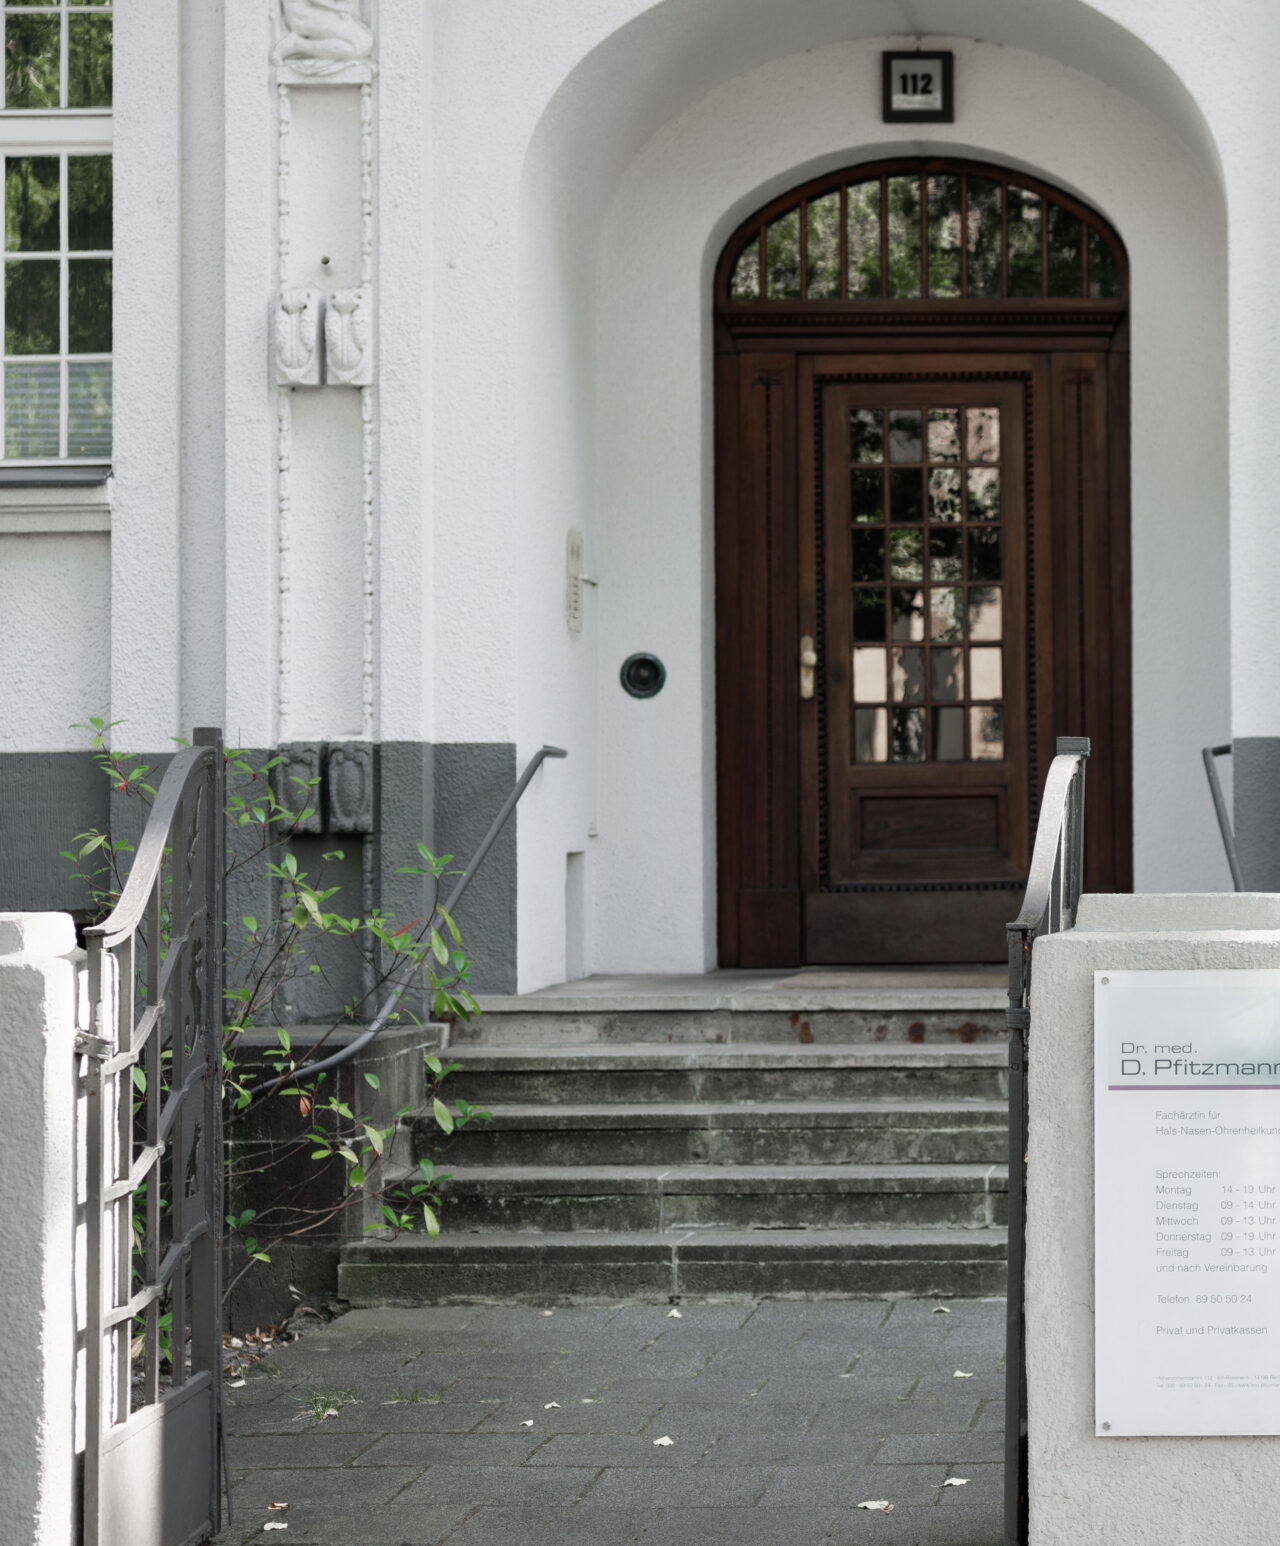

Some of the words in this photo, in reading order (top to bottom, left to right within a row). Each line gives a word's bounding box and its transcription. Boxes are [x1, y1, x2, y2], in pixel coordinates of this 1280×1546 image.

[900, 73, 933, 95] 112
[1121, 1042, 1148, 1054] Dr.
[1154, 1042, 1198, 1054] med.
[1121, 1059, 1146, 1076] D.
[1155, 1110, 1206, 1120] Fachärztin
[1208, 1110, 1221, 1120] für
[1155, 1185, 1192, 1196] Montag
[1220, 1184, 1233, 1194] 14
[1258, 1184, 1276, 1194] Uhr
[1155, 1201, 1199, 1212] Dienstag
[1220, 1200, 1233, 1209] 09
[1258, 1200, 1276, 1209] Uhr
[1155, 1216, 1199, 1225] Mittwoch
[1220, 1216, 1233, 1225] 09
[1258, 1216, 1276, 1225] Uhr
[1155, 1232, 1212, 1243] Donnerstag
[1220, 1232, 1233, 1241] 09
[1258, 1232, 1276, 1241] Uhr
[1155, 1248, 1189, 1259] Freitag
[1220, 1247, 1233, 1256] 09
[1258, 1247, 1276, 1256] Uhr
[1155, 1263, 1175, 1272] und
[1177, 1263, 1201, 1272] nach
[1204, 1263, 1268, 1274] Vereinbarung
[1156, 1294, 1190, 1304] Telefon
[1210, 1294, 1223, 1303] 50
[1225, 1294, 1238, 1303] 50
[1240, 1294, 1252, 1303] 24
[1156, 1325, 1184, 1335] Privat
[1185, 1325, 1205, 1335] und
[1207, 1325, 1268, 1335] Privatkassen
